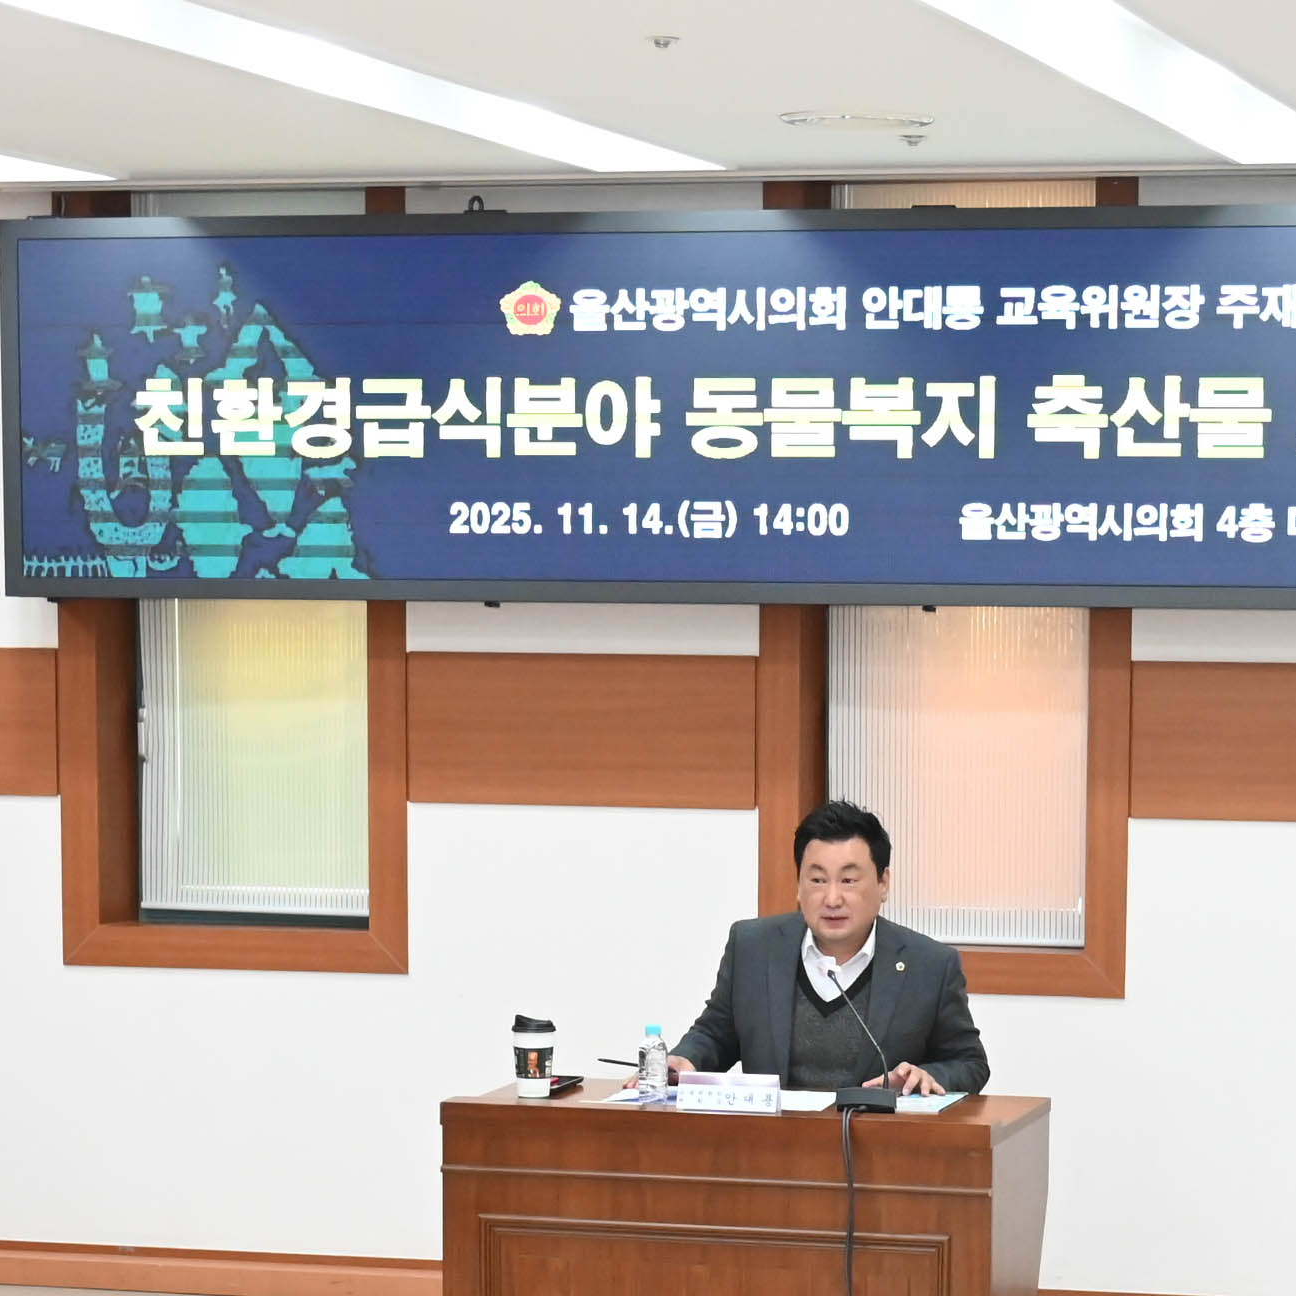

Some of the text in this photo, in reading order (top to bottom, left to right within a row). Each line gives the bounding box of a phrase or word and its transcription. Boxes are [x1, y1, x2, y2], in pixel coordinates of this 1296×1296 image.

[569, 286, 846, 331] 울산광역시의회
[996, 284, 1205, 330] 교육위원장
[134, 376, 661, 459] 친환경급식분야
[685, 375, 996, 459] 동물복지
[1027, 374, 1272, 459] 축산물
[449, 500, 850, 538] 2025. 11. 14.(금) 14:00
[959, 501, 1204, 542] 울산광역시의회
[1216, 502, 1275, 543] 4층
